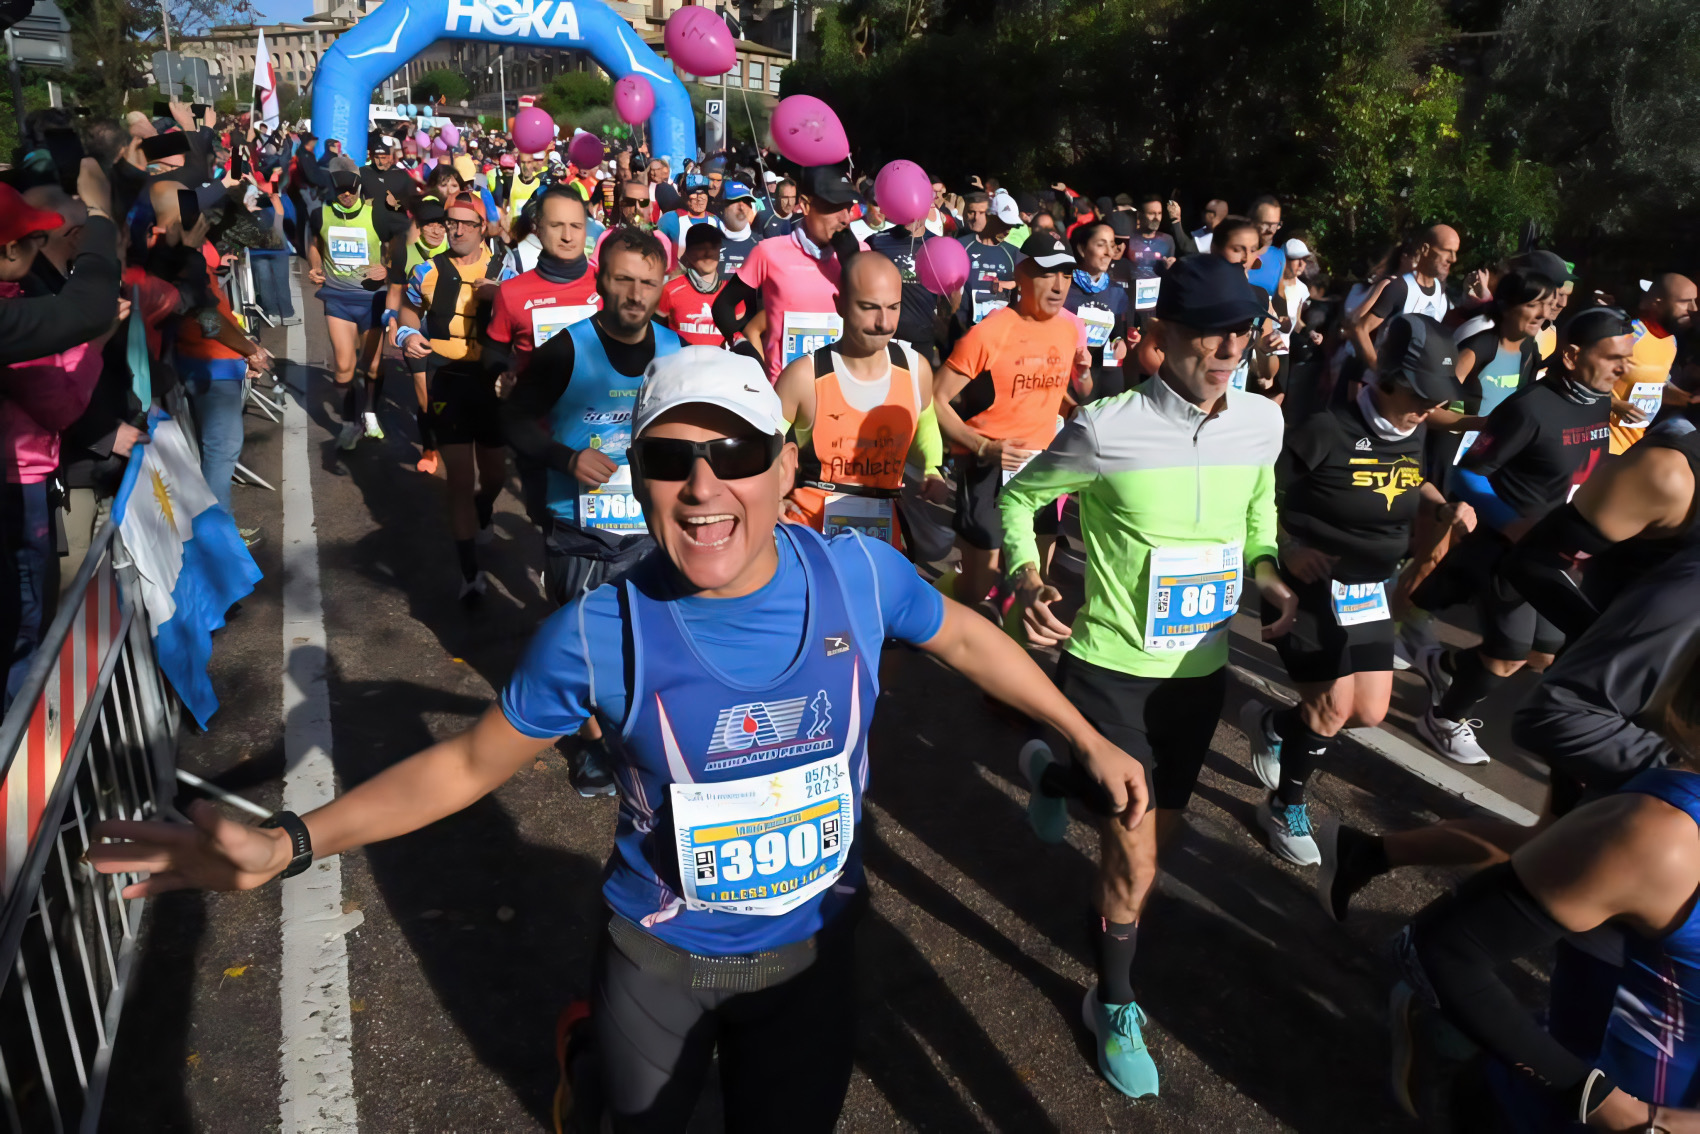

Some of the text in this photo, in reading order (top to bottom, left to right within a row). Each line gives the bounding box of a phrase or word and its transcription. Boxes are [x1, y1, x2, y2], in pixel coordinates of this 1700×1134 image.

[445, 0, 580, 40] HOKA
[1181, 583, 1217, 618] 86
[805, 777, 839, 798] 2023
[720, 823, 818, 882] 390
